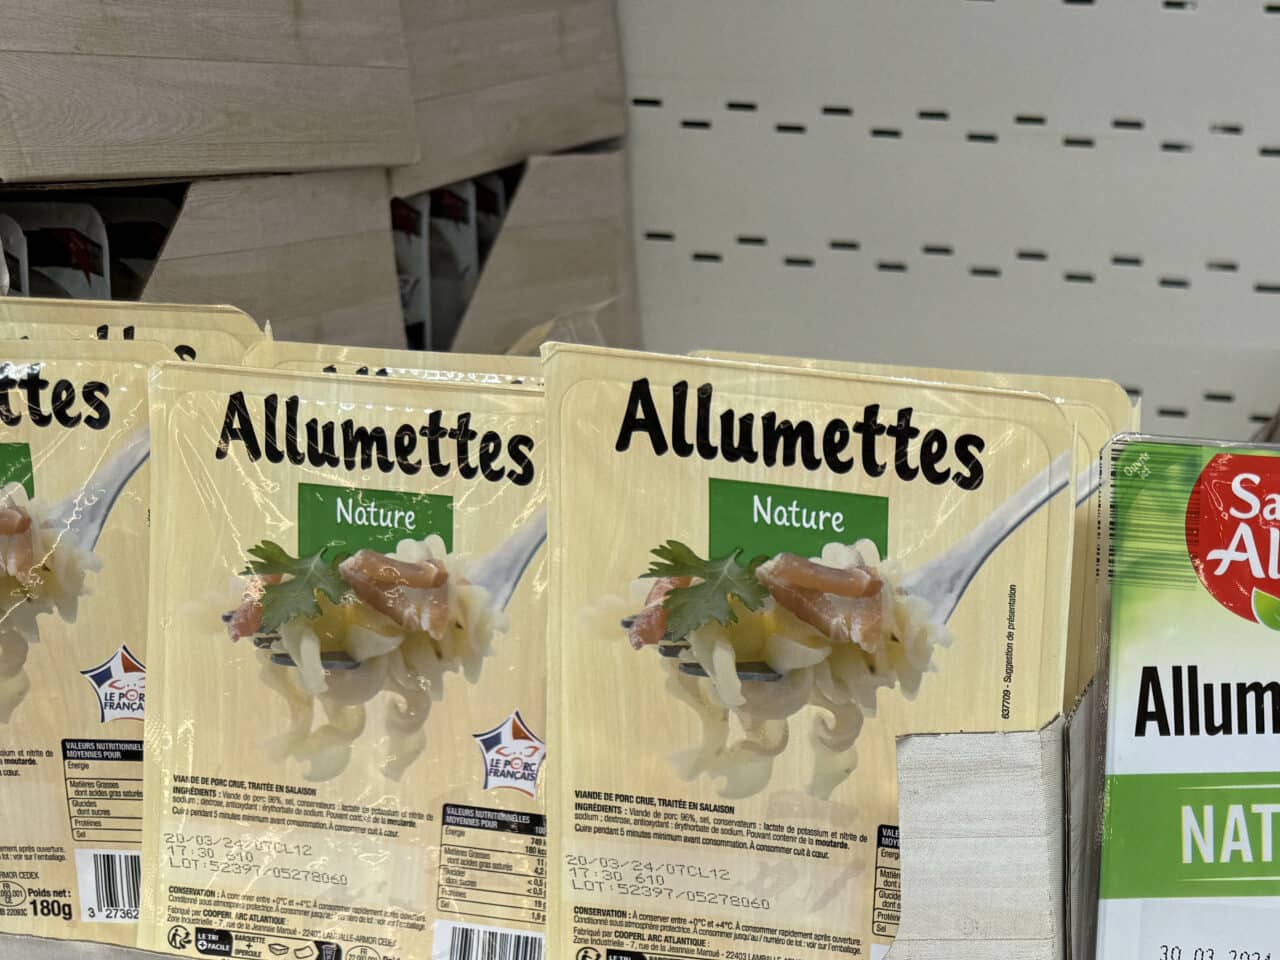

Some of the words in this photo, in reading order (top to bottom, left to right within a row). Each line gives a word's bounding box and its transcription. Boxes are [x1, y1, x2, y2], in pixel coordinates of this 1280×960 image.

[216, 391, 535, 486] Allumettes
[615, 377, 985, 491] Allumettes
[336, 498, 416, 530] Nature
[753, 495, 845, 533] Nature
[1007, 584, 1016, 630] présentation
[1006, 631, 1015, 641] de
[1003, 643, 1013, 683] Suggestion
[105, 692, 115, 701] LE
[119, 689, 145, 702] POR
[104, 701, 144, 712] FRANÇA
[67, 750, 102, 759] MOYENNES
[103, 751, 121, 759] POUR
[490, 757, 500, 768] LE
[504, 757, 536, 772] PORC
[488, 767, 537, 781] FRANÇAIS
[575, 790, 602, 801] VIANDE
[604, 792, 612, 801] DE
[614, 793, 634, 804] PORC
[658, 797, 687, 809] TRAITÉE
[688, 801, 698, 811] EN
[699, 802, 735, 815] SALAISON
[167, 844, 214, 859] 17:30
[565, 854, 731, 881] 20/03/24/07CL12
[569, 867, 622, 882] 17:30
[635, 873, 665, 886] 610
[28, 888, 51, 897] Poids
[53, 889, 66, 898] net
[571, 878, 770, 910] LOT:52397/05278060
[29, 899, 73, 920] 180g
[614, 929, 646, 942] COOPERL
[647, 932, 662, 943] ARC
[664, 934, 707, 947] ATLANTIQUE
